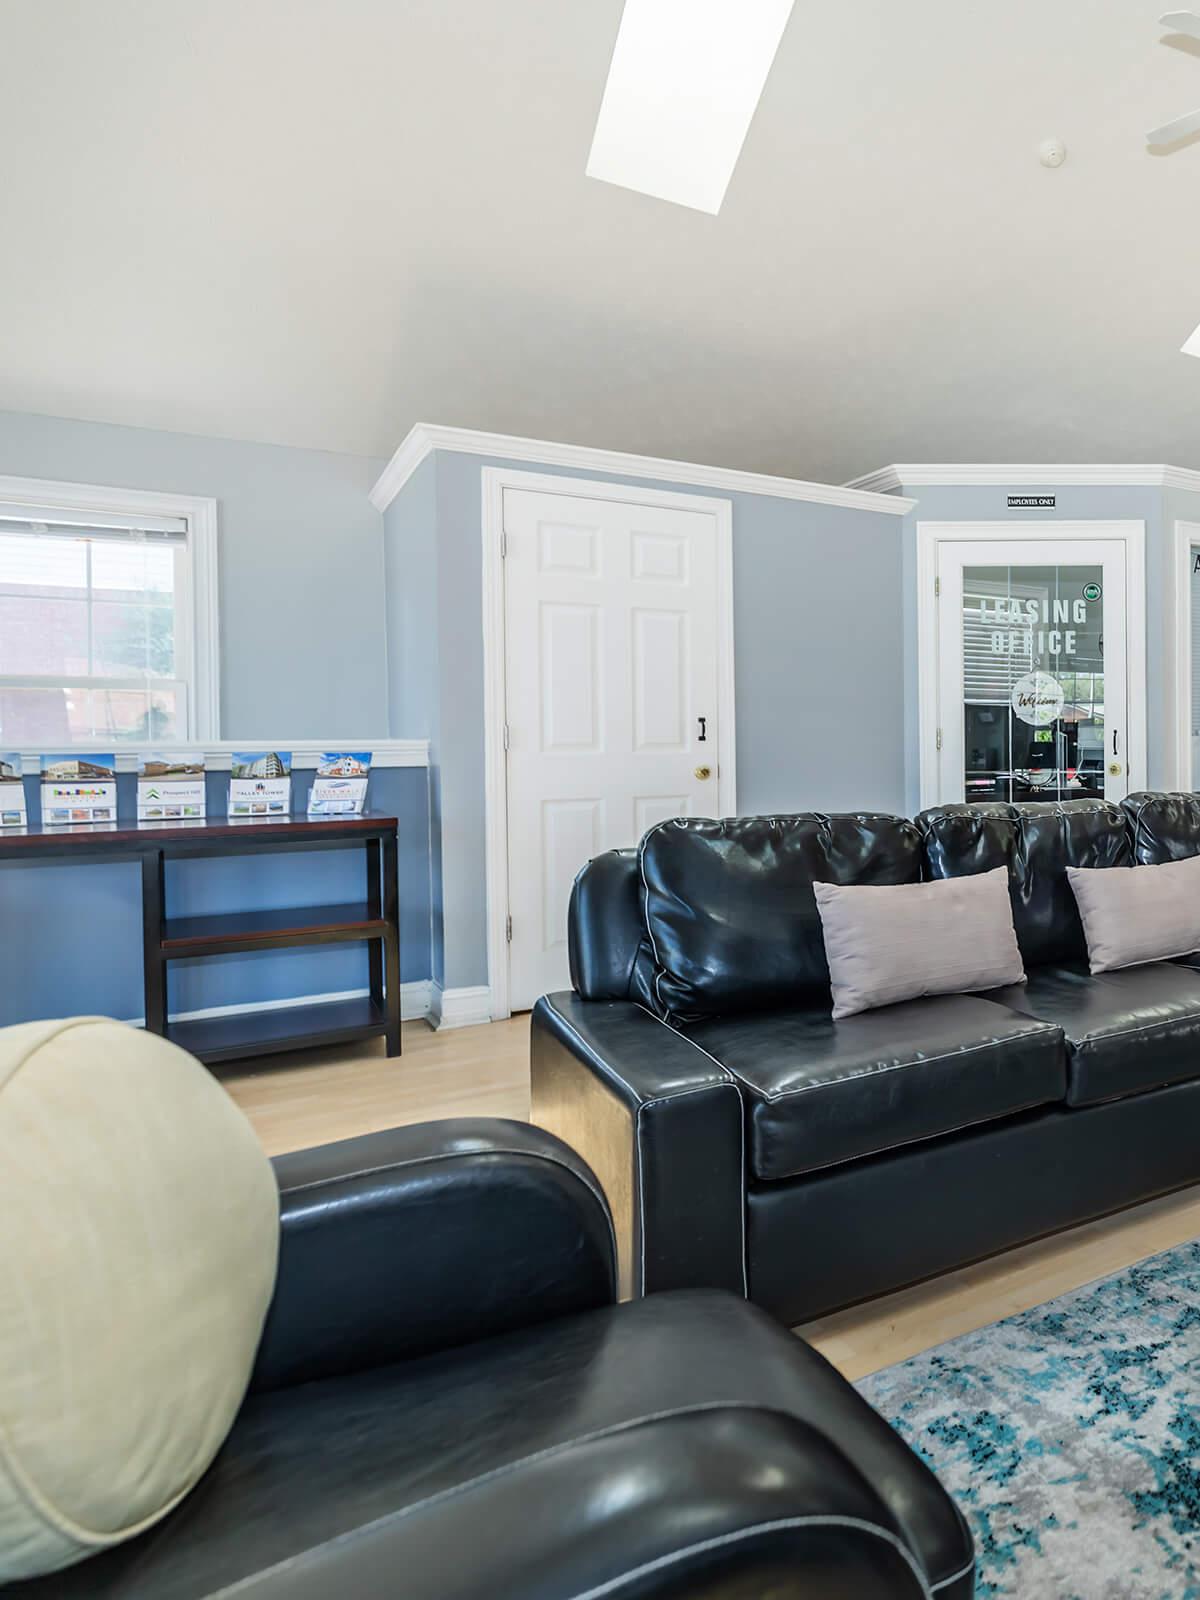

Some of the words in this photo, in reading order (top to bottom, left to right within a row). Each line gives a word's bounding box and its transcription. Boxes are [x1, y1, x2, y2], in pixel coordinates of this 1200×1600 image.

[980, 599, 1087, 624] LEASING
[991, 630, 1077, 656] OFFICE
[1017, 692, 1058, 708] Welcome
